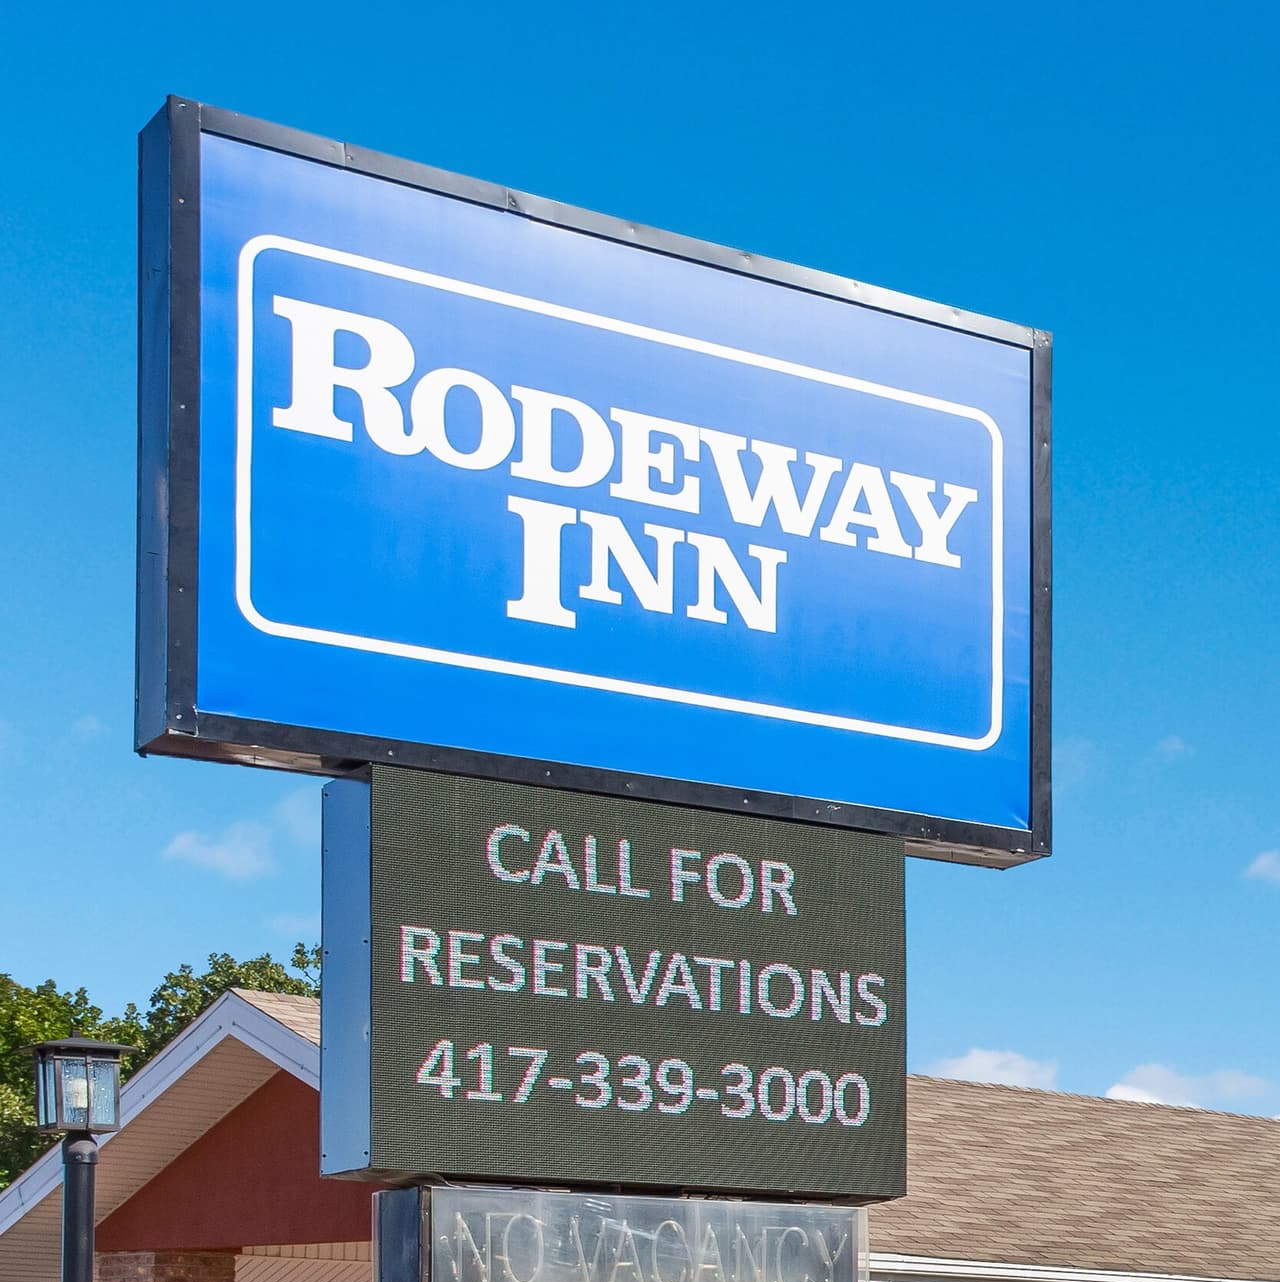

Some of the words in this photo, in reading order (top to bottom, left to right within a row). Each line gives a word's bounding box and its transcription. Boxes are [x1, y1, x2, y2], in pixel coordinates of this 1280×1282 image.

[272, 295, 978, 569] RODEWAY
[506, 496, 787, 634] INN
[486, 824, 650, 899] CALL
[670, 848, 798, 915] FOR
[400, 925, 887, 1027] RESERVATIONS
[416, 1039, 871, 1127] 417-339-3000
